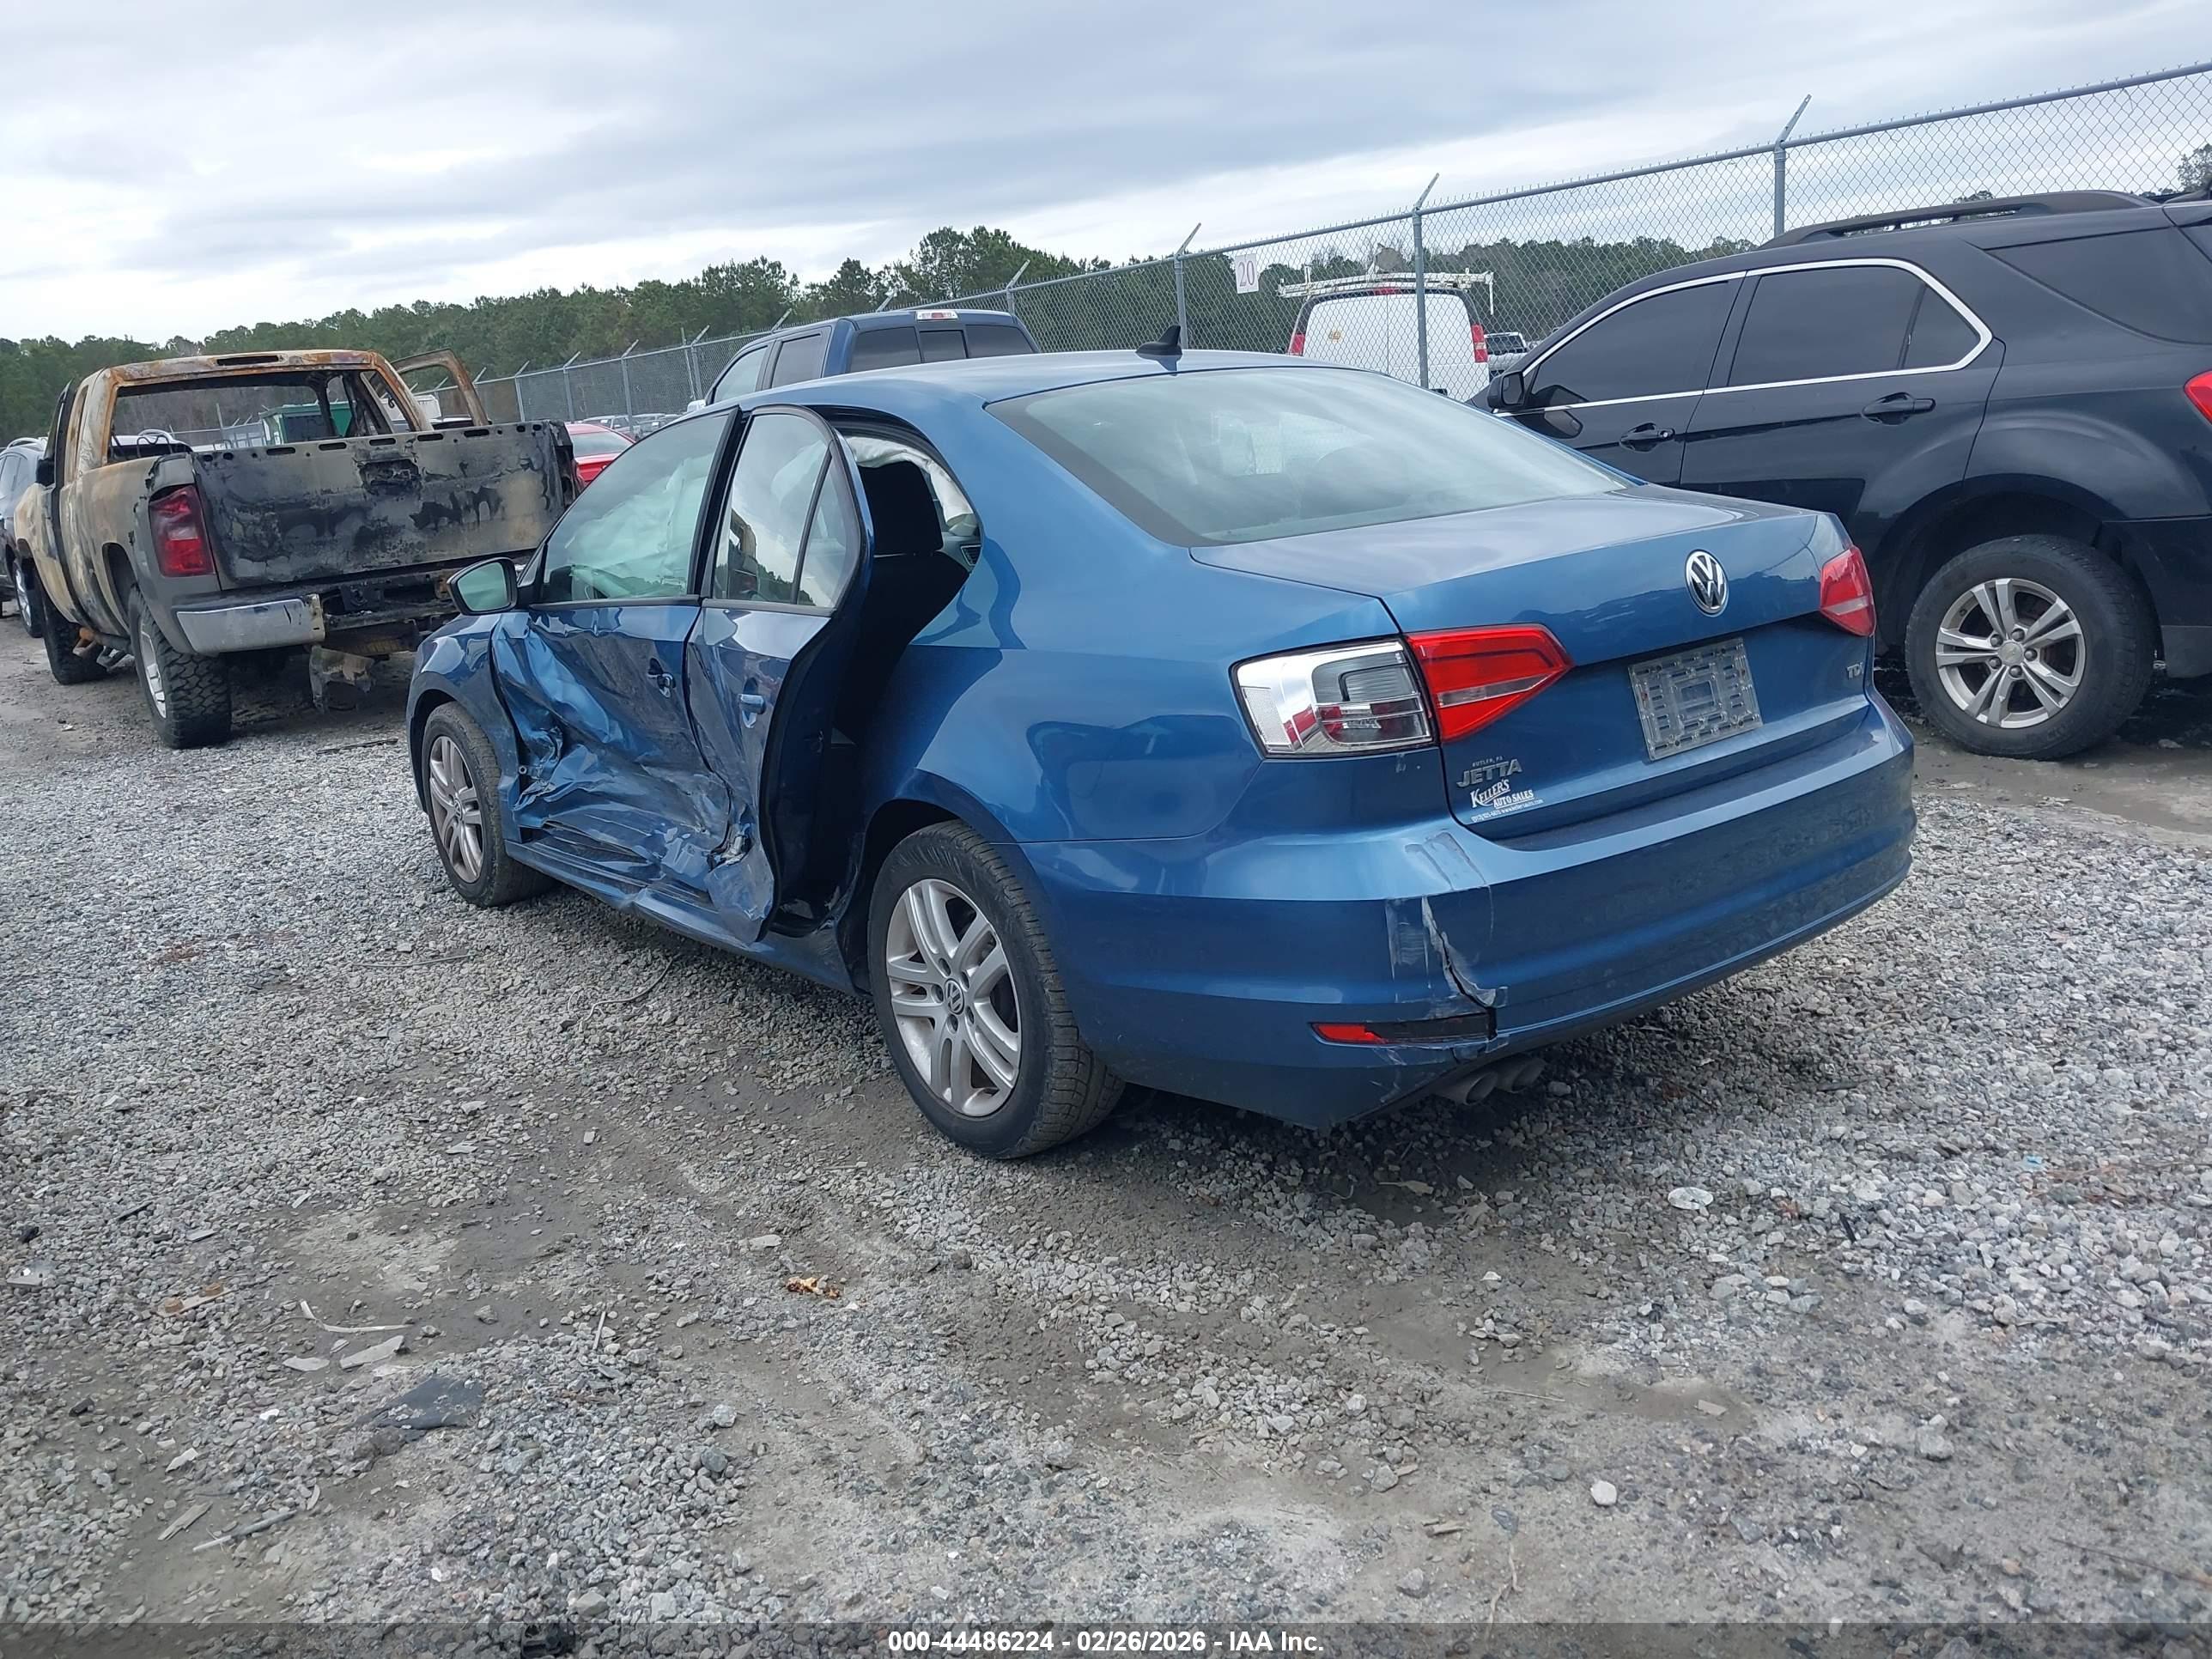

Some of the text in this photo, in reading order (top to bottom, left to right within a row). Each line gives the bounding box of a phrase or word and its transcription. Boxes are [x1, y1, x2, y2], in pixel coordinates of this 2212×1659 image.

[1237, 260, 1255, 287] 20
[1456, 759, 1522, 787] JETTA
[1470, 779, 1510, 808] KELLER'S
[1494, 789, 1534, 807] AUTO SALES
